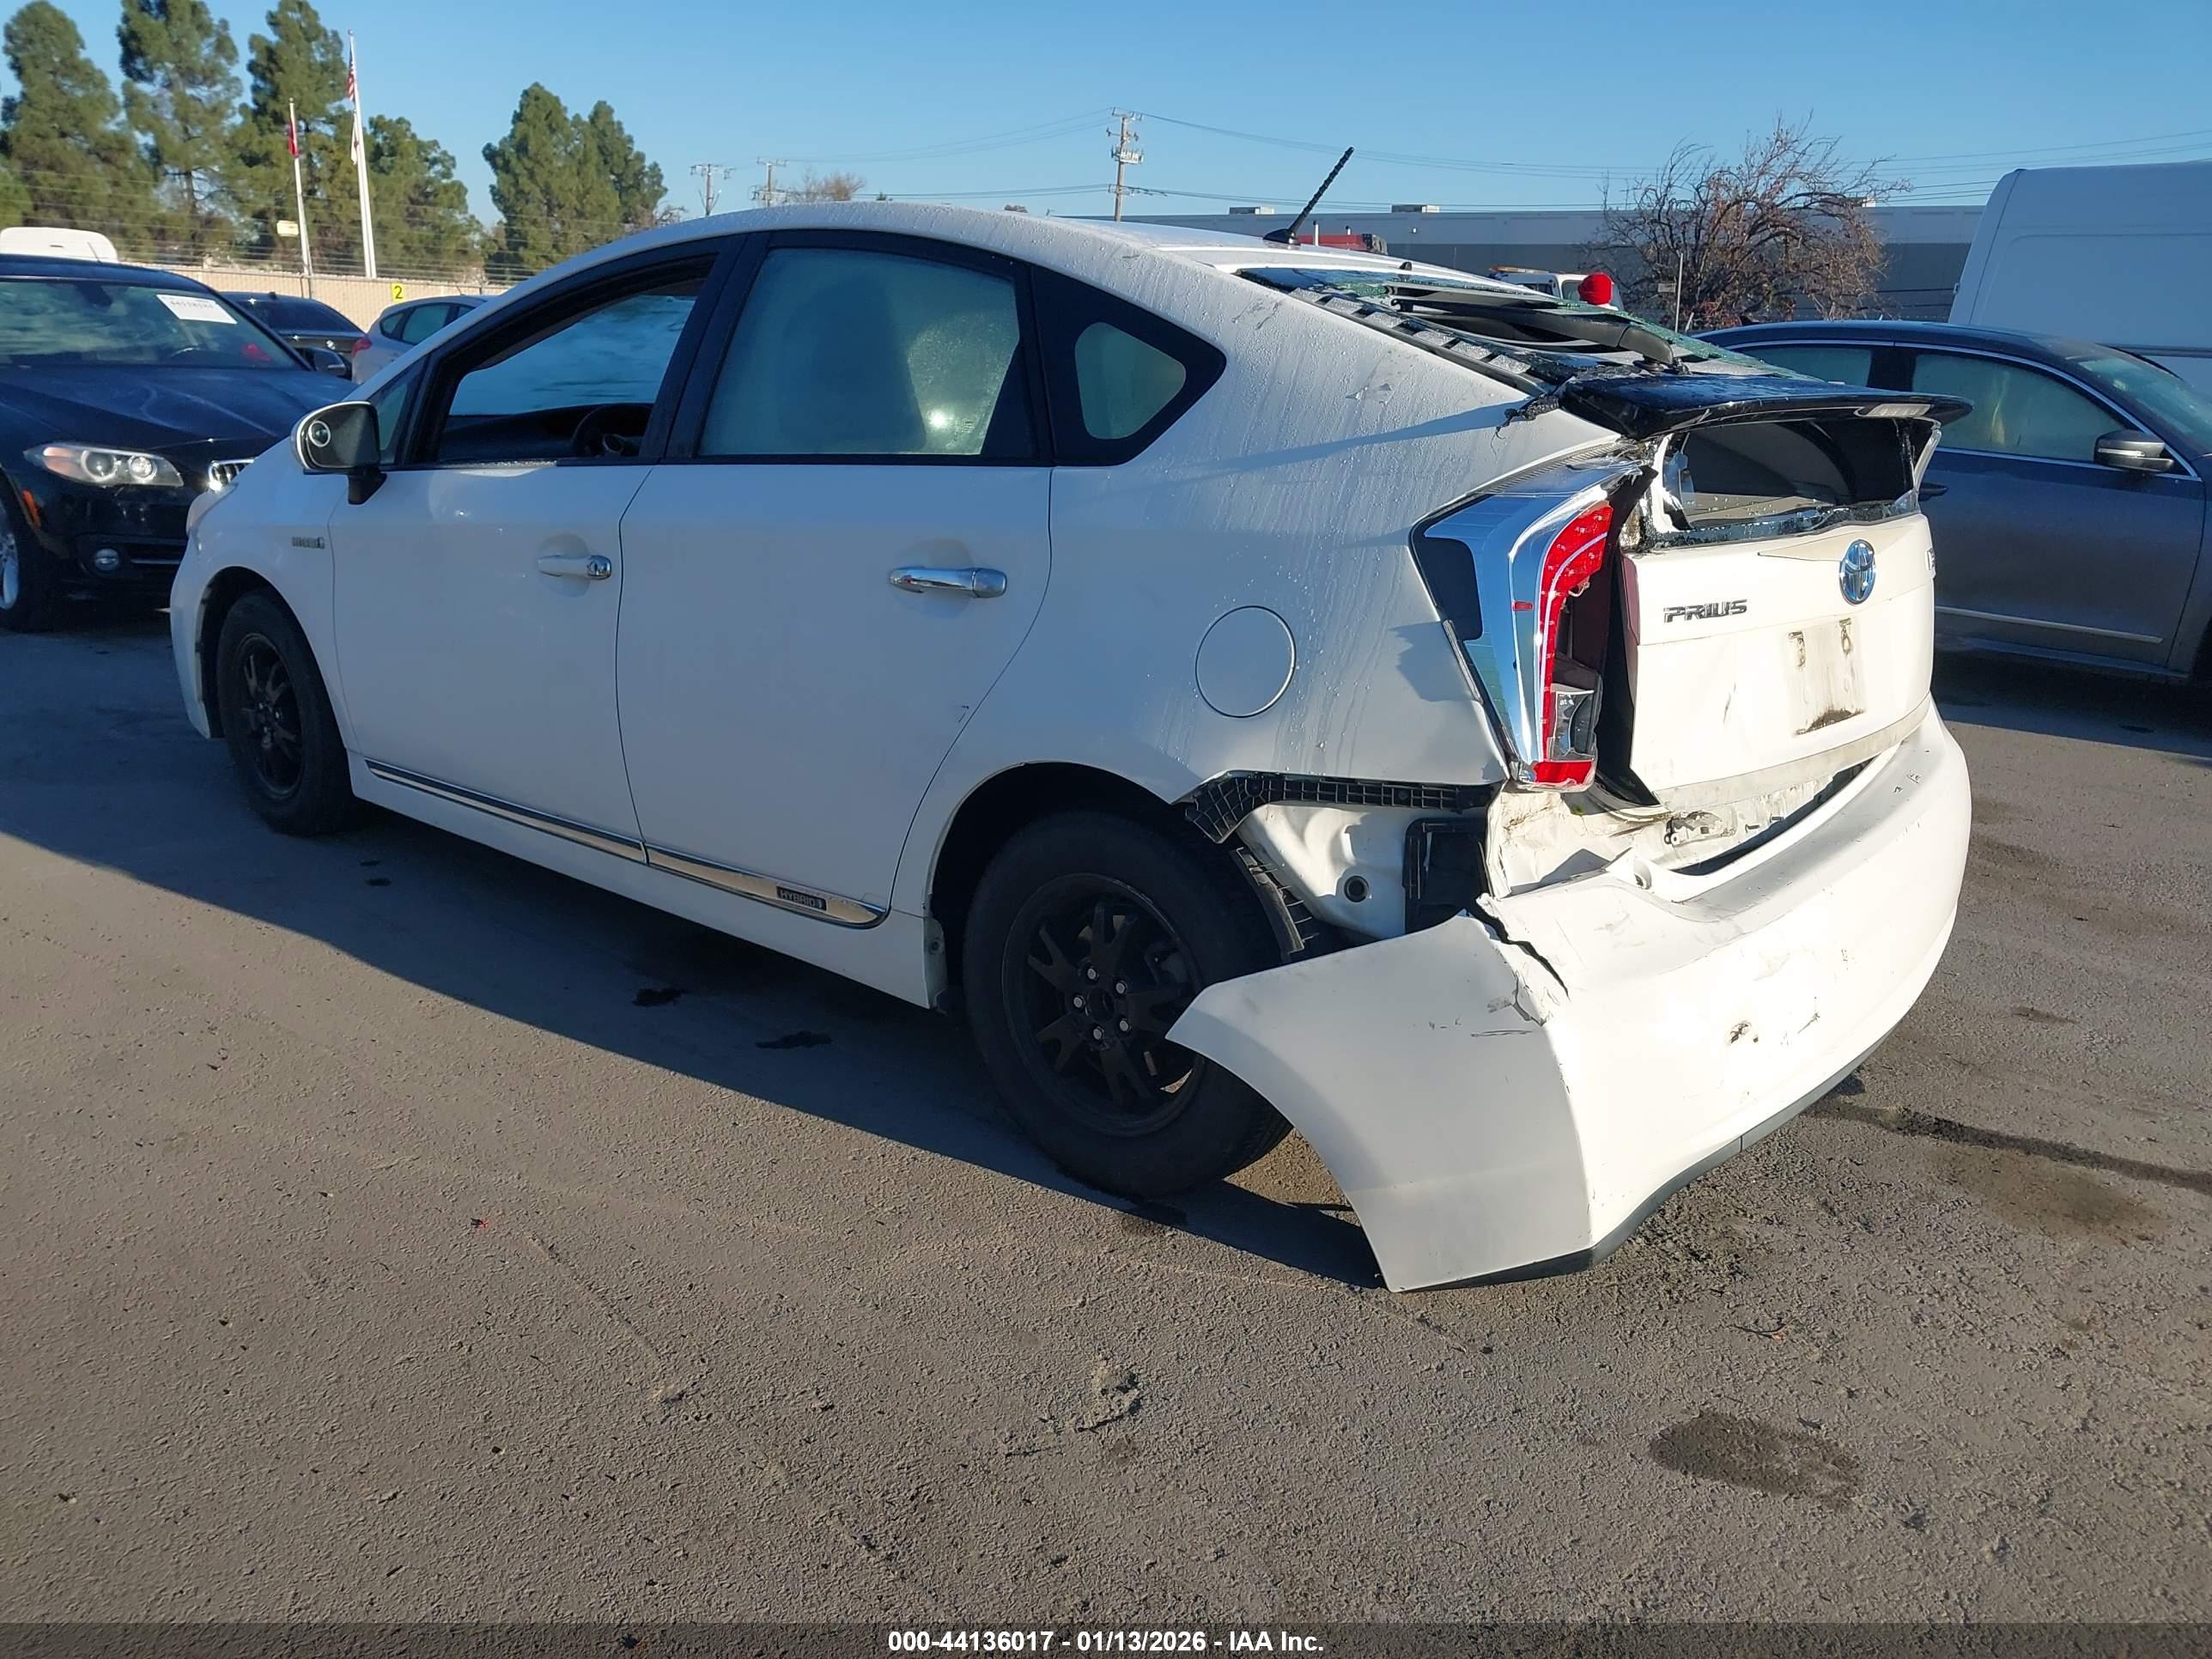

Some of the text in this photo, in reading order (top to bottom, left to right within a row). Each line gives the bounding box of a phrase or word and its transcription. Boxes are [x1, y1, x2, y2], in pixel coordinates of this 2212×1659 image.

[394, 285, 404, 299] 2
[1663, 599, 1747, 623] PRIUS
[780, 888, 817, 908] HYBRID
